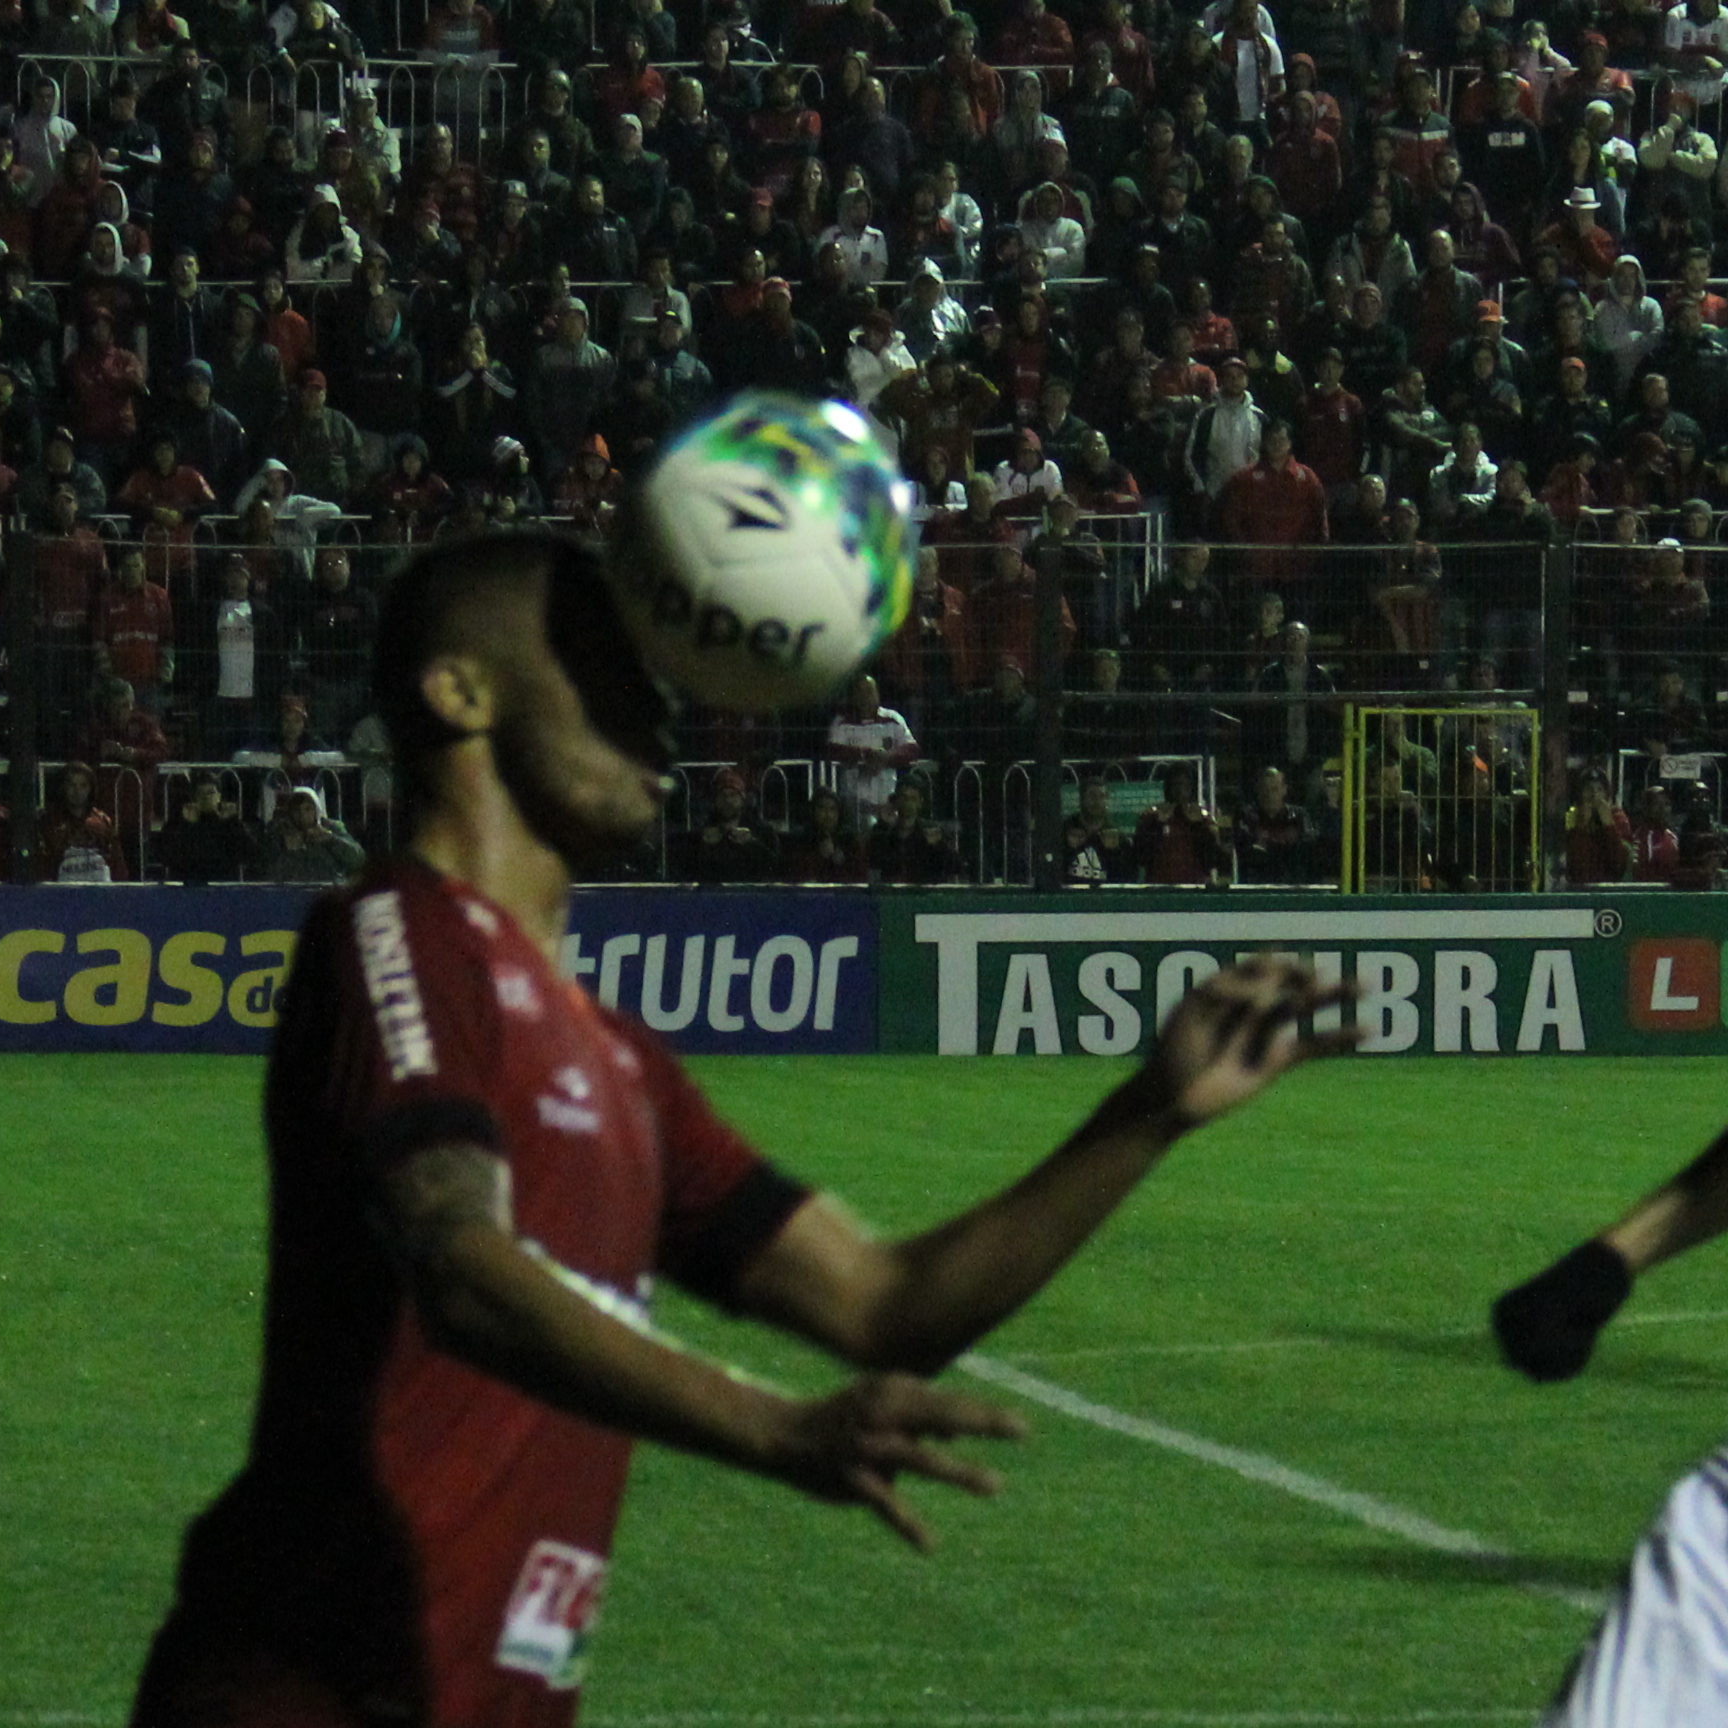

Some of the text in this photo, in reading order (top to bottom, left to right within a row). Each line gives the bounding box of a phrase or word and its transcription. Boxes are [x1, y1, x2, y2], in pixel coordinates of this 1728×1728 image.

[652, 578, 826, 668] pper
[558, 932, 860, 1033] trutor
[915, 908, 1595, 1056] TASCIBRA
